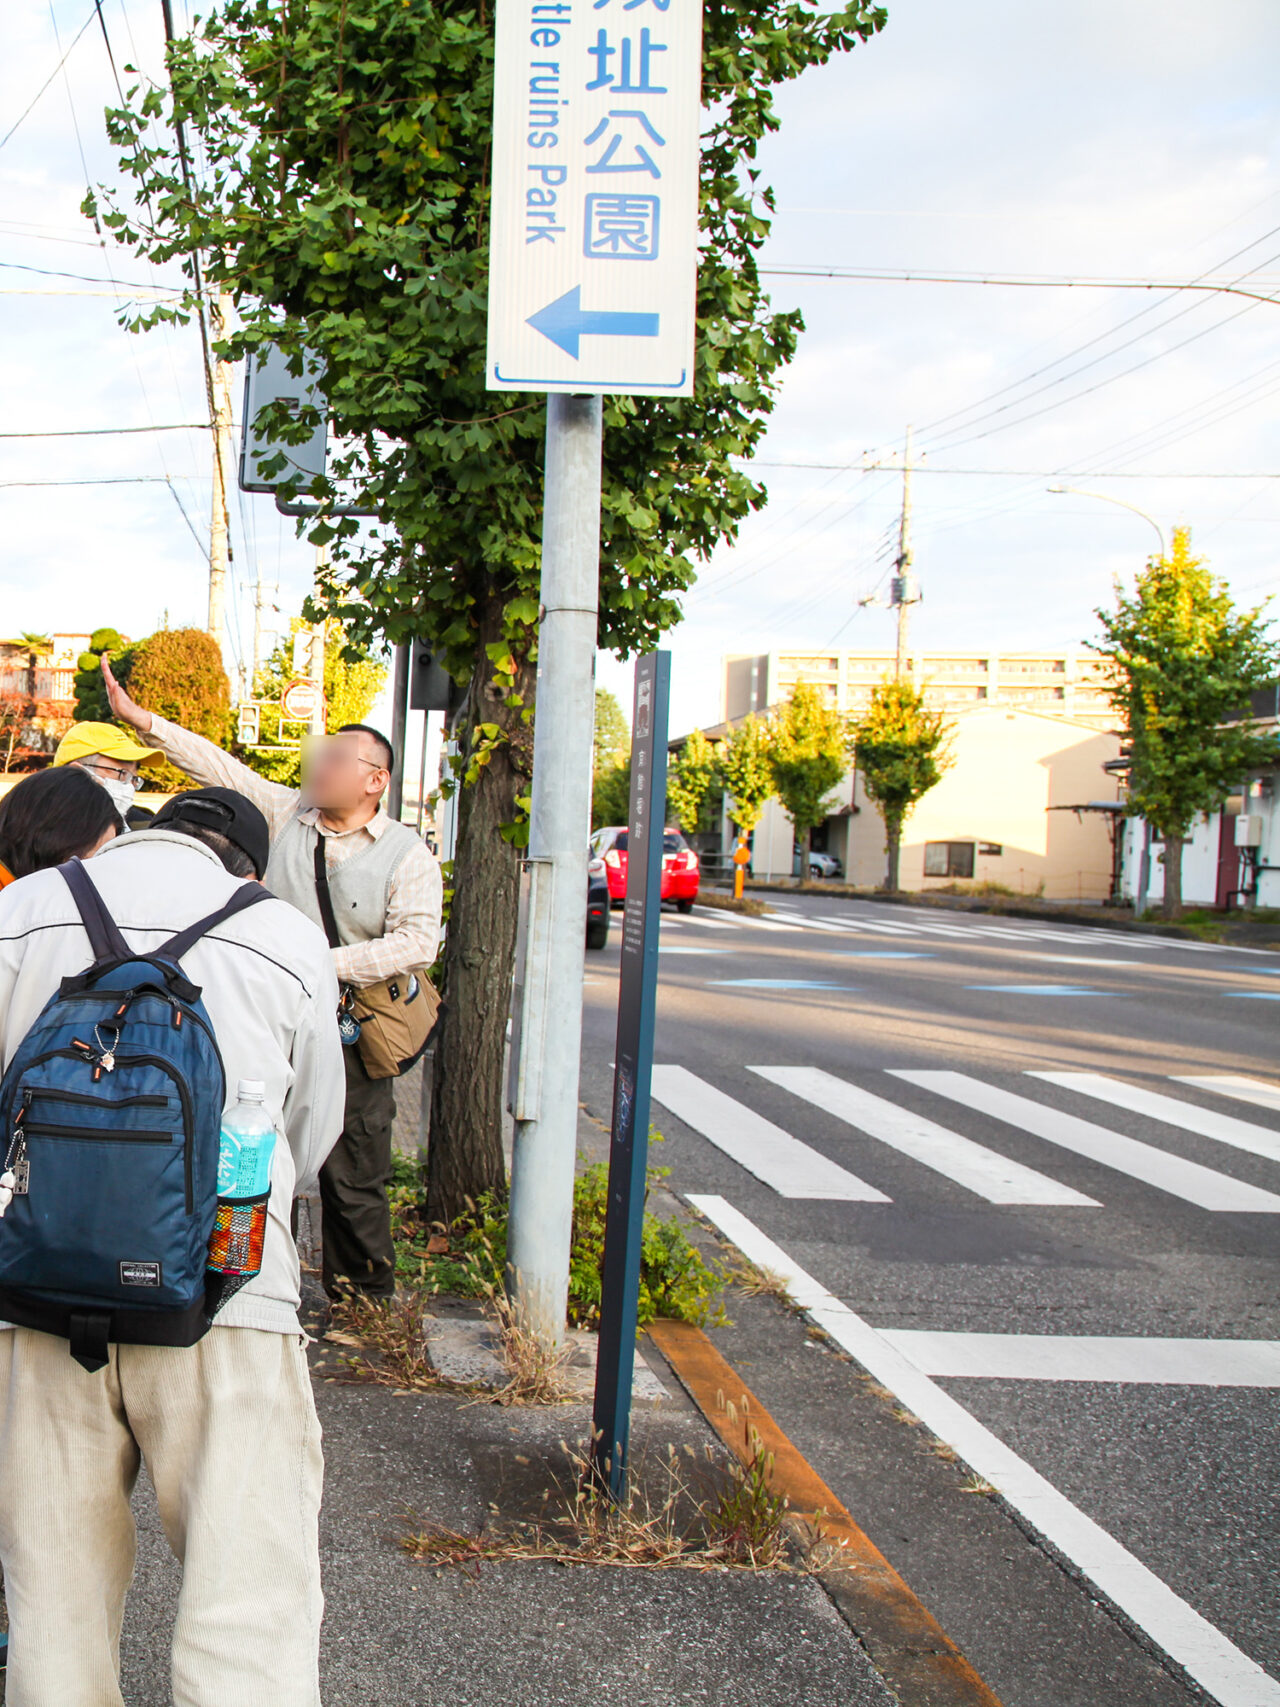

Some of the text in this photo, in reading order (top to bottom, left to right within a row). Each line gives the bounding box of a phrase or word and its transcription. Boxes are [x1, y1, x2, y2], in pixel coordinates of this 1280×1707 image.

[525, 0, 572, 245] tle ruins Park
[583, 0, 669, 261] 址公園
